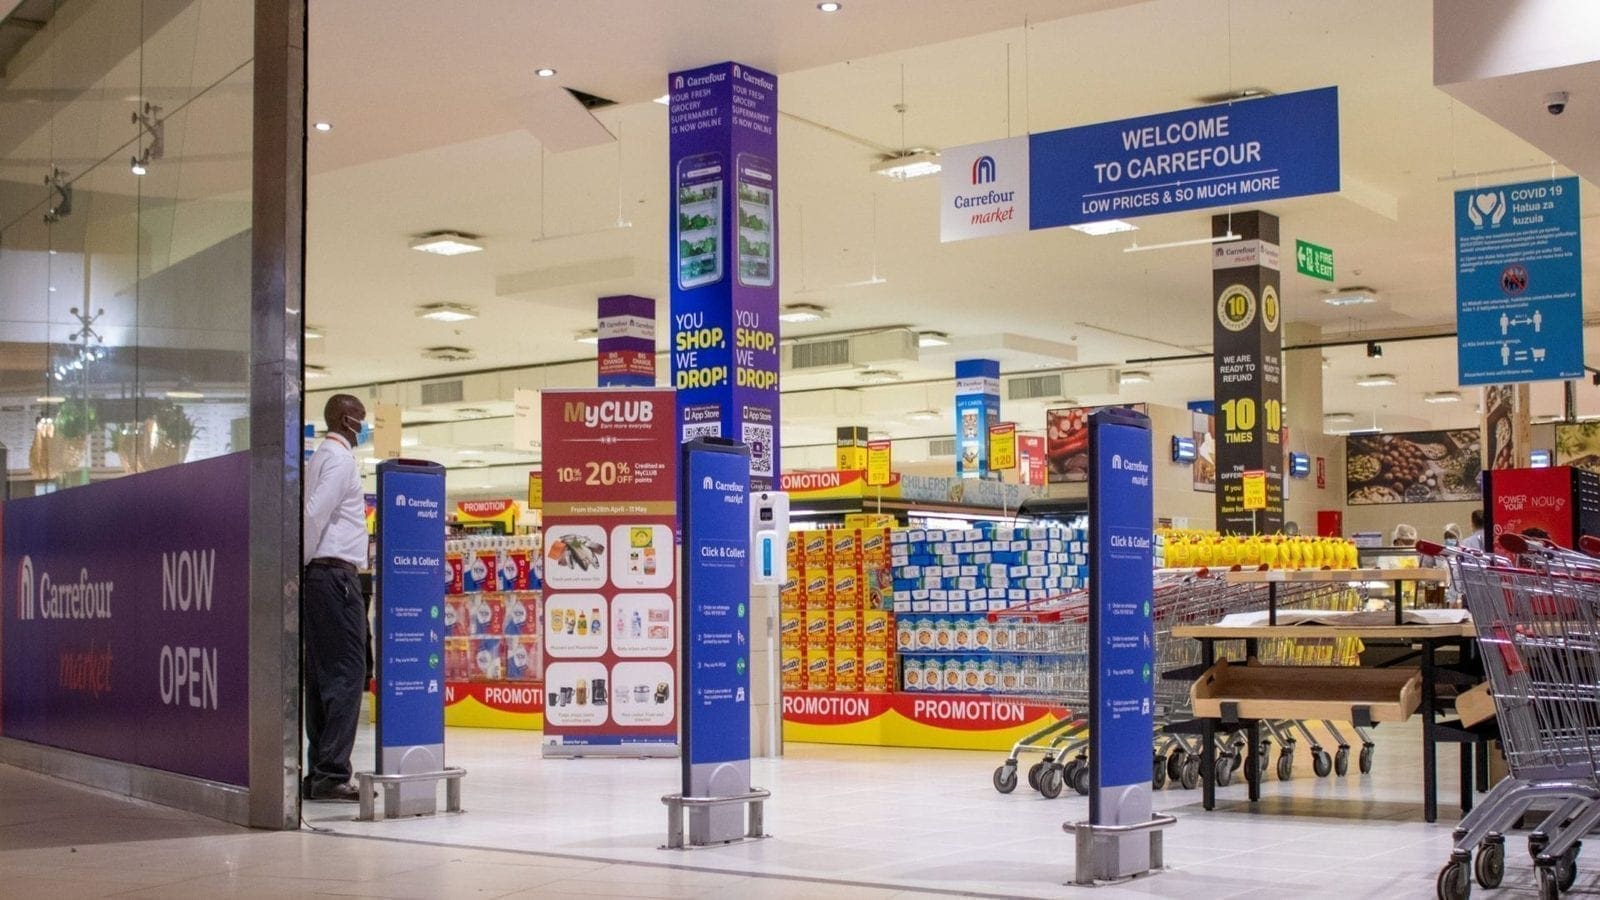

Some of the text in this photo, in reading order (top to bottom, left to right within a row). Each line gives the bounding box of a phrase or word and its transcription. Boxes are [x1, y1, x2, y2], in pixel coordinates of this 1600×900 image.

[688, 73, 726, 87] Carrefour
[743, 71, 774, 91] Carrefour
[671, 88, 711, 103] YOUR FRESH
[733, 85, 765, 100] YOUR FRESH
[671, 101, 701, 113] GROCERY
[732, 95, 756, 108] GROCERY
[671, 107, 718, 124] SUPERMARKET
[732, 105, 770, 123] SUPERMARKET
[671, 117, 722, 134] IS NOW ONLINE
[732, 116, 773, 135] IS NOW ONLINE
[1121, 116, 1229, 151] WELCOME
[1093, 141, 1262, 184] TO CARREFOUR
[954, 190, 1014, 210] Carrefour
[1081, 176, 1280, 215] LOW PRICES & SO MUCH MORE
[1511, 186, 1563, 201] COVID 19
[1512, 201, 1554, 213] Hatua za
[971, 206, 1014, 225] market
[1512, 215, 1544, 226] kuzuia
[1226, 247, 1256, 256] Carrefour
[1227, 295, 1246, 315] 10
[676, 312, 703, 331] YOU
[736, 310, 759, 329] YOU
[676, 328, 725, 351] SHOP,
[736, 328, 777, 355] SHOP,
[676, 351, 698, 369] WE
[736, 350, 755, 367] WE
[1223, 354, 1251, 364] WE ARE
[1220, 363, 1256, 374] READY TO
[677, 366, 727, 390] DROP!
[737, 367, 778, 391] DROP!
[1222, 373, 1253, 383] REFUND
[564, 400, 654, 428] MyCLUB
[691, 410, 720, 421] App Store
[748, 411, 759, 421] App
[1221, 398, 1256, 431] 10
[1264, 399, 1281, 432] 10
[1224, 431, 1253, 444] TIMES
[1266, 432, 1279, 444] TIMES
[634, 462, 658, 470] Credited
[994, 454, 1011, 466] 120
[1123, 458, 1148, 473] Carrefour
[617, 475, 633, 484] OFF
[634, 469, 658, 478] MyCLUB
[634, 477, 652, 485] points
[781, 473, 840, 489] OMOTION
[1132, 474, 1148, 487] market
[715, 480, 744, 492] Carrefour
[902, 476, 948, 492] CHILLERS
[978, 481, 1019, 498] CHILLERS
[408, 498, 438, 508] Carrefour
[464, 501, 505, 511] PROMOTION
[724, 494, 744, 505] market
[1498, 494, 1528, 504] POWER
[417, 510, 438, 519] market
[610, 506, 625, 514] April
[634, 506, 648, 514] May
[1504, 503, 1524, 511] YOUR
[1110, 535, 1150, 548] Click & Collect
[701, 547, 745, 558] Click & Collect
[393, 556, 440, 566] Click & Collect
[162, 548, 216, 612] NOW
[40, 567, 114, 619] Carrefour
[159, 644, 218, 710] OPEN
[485, 688, 543, 705] PROMOTI
[782, 696, 869, 716] ROMOTION
[914, 700, 1025, 721] PROMOTION
